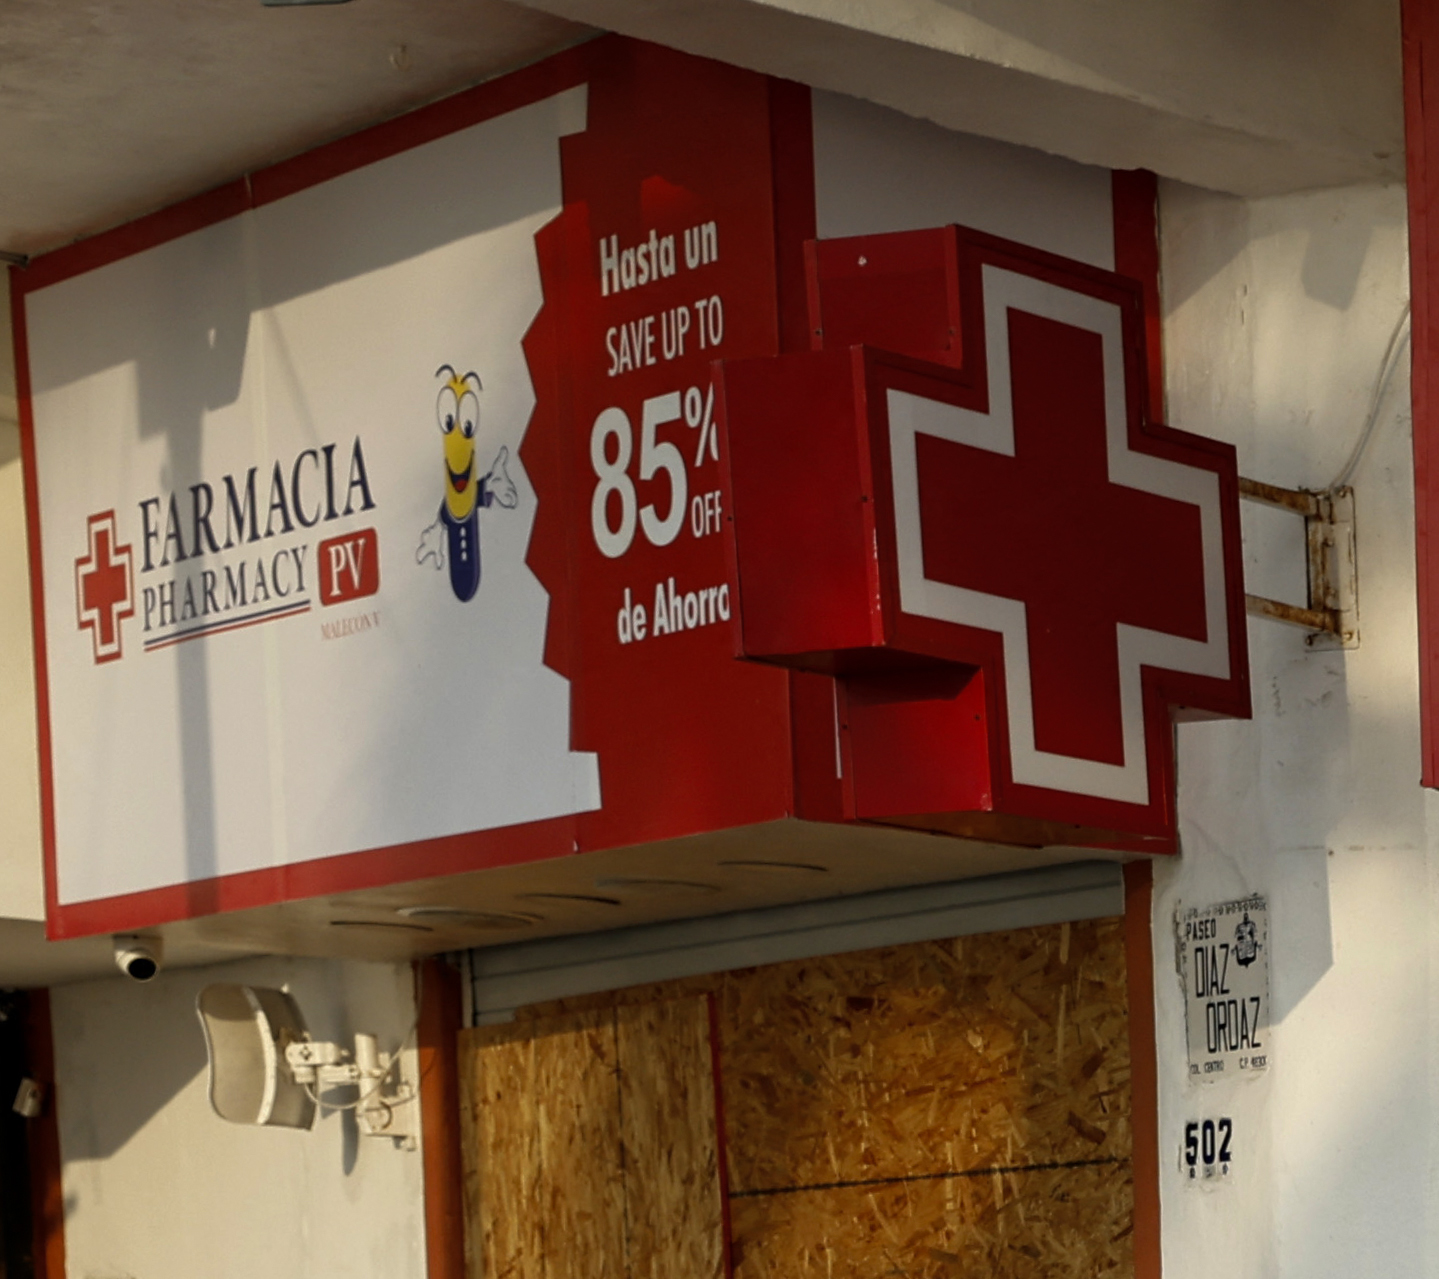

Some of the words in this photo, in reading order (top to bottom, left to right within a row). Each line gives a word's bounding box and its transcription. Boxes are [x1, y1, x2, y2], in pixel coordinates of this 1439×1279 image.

[599, 228, 677, 297] Hasta
[684, 220, 719, 269] un
[605, 314, 657, 378] SAVE
[662, 305, 691, 360] UP
[694, 295, 724, 350] TO
[138, 435, 377, 573] FARMACIA
[590, 382, 720, 559] 85%
[142, 544, 311, 632] PHARMACY
[328, 538, 366, 598] PV
[617, 586, 647, 644] de
[1185, 917, 1217, 942] PASEO
[1194, 943, 1230, 998] DIAZ
[1206, 996, 1262, 1054] ORDAZ
[1184, 1117, 1233, 1167] 502
